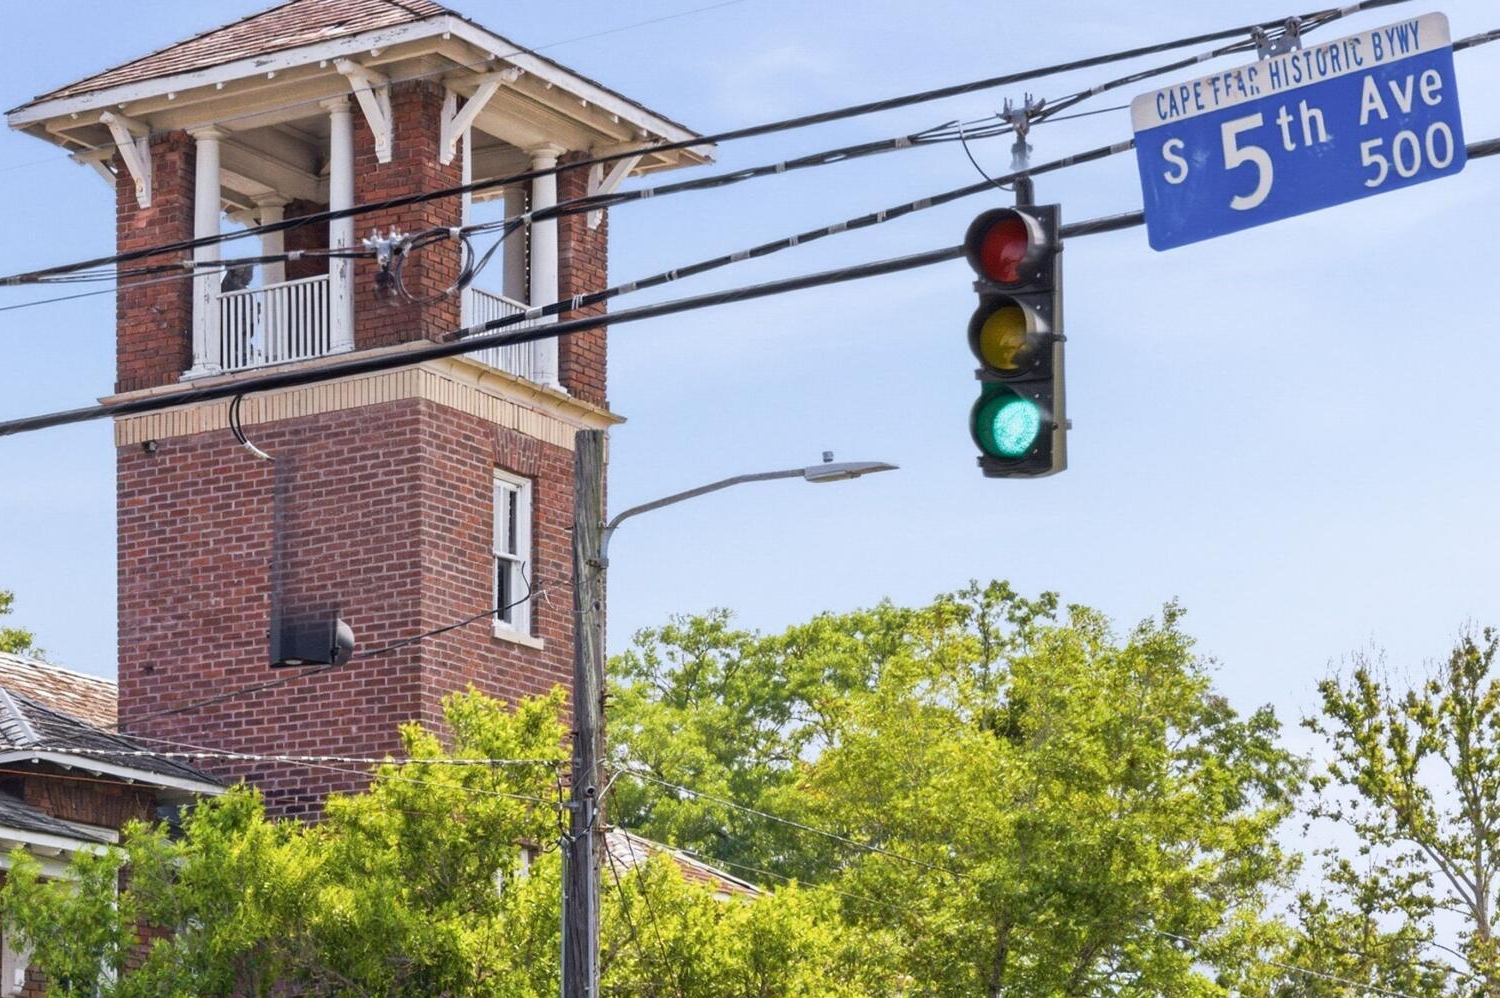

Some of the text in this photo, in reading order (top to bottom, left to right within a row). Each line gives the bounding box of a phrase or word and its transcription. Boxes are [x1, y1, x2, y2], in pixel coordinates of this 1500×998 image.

[1156, 81, 1203, 120] CAPE
[1268, 38, 1364, 90] HISTORIC
[1372, 20, 1421, 61] BYWY
[1162, 69, 1443, 211] S 5th Ave
[1360, 122, 1454, 188] 500
